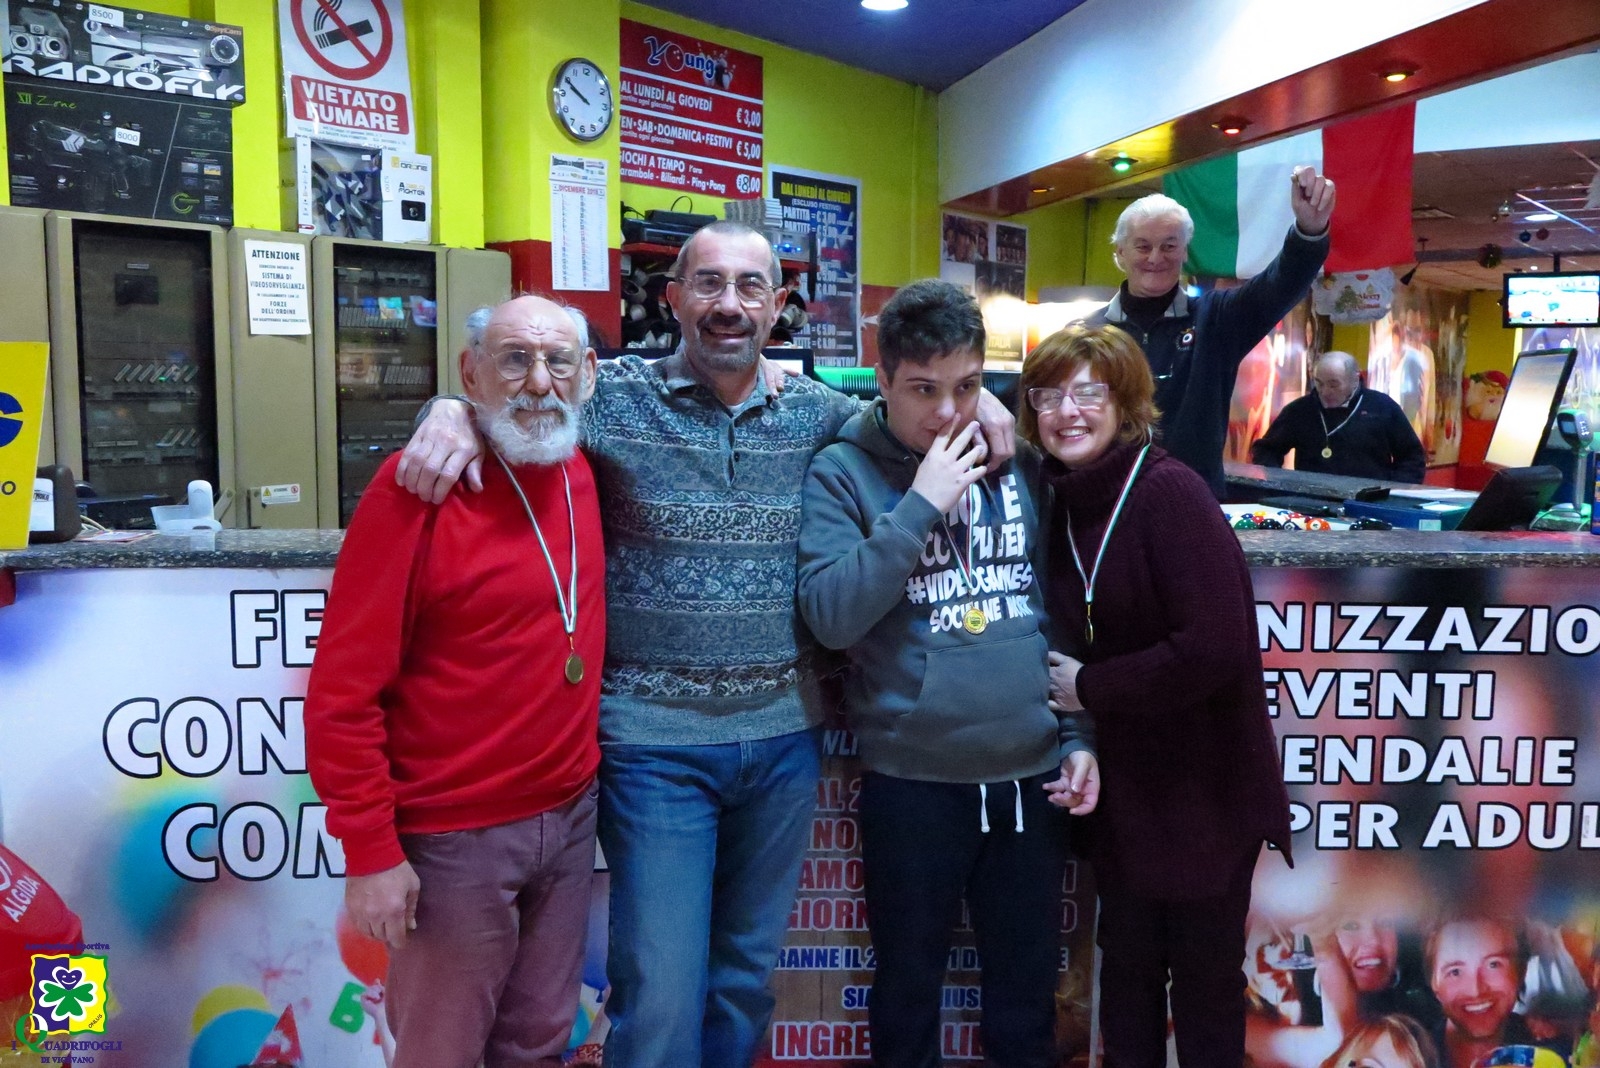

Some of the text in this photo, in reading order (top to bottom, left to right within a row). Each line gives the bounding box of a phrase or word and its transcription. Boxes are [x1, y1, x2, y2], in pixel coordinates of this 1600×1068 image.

[91, 9, 114, 20] 8500
[2, 54, 245, 101] RADIOFLY
[583, 68, 590, 76] 12
[301, 80, 397, 112] VIETATO
[602, 103, 608, 111] 3
[666, 91, 677, 104] AL
[744, 110, 761, 128] 3,00
[305, 101, 400, 132] FUMARE
[570, 118, 576, 126] 7
[580, 125, 586, 133] 6
[590, 124, 597, 132] 5
[116, 130, 139, 143] 8000
[744, 142, 761, 160] 5,00
[649, 156, 655, 168] A
[657, 157, 686, 173] TEMPO
[783, 205, 811, 221] PARTITA
[252, 249, 299, 261] ATTENZIONE
[262, 272, 284, 280] SISTEMA
[250, 280, 305, 290] VIDEOSORVEGLIANZA
[270, 300, 287, 308] FORZE
[1255, 601, 1600, 655] NIZZAZIO
[102, 696, 310, 779] CON
[1280, 734, 1577, 786] ENDALIE
[1268, 800, 1401, 851] PER
[1, 875, 41, 923] ALGIDA
